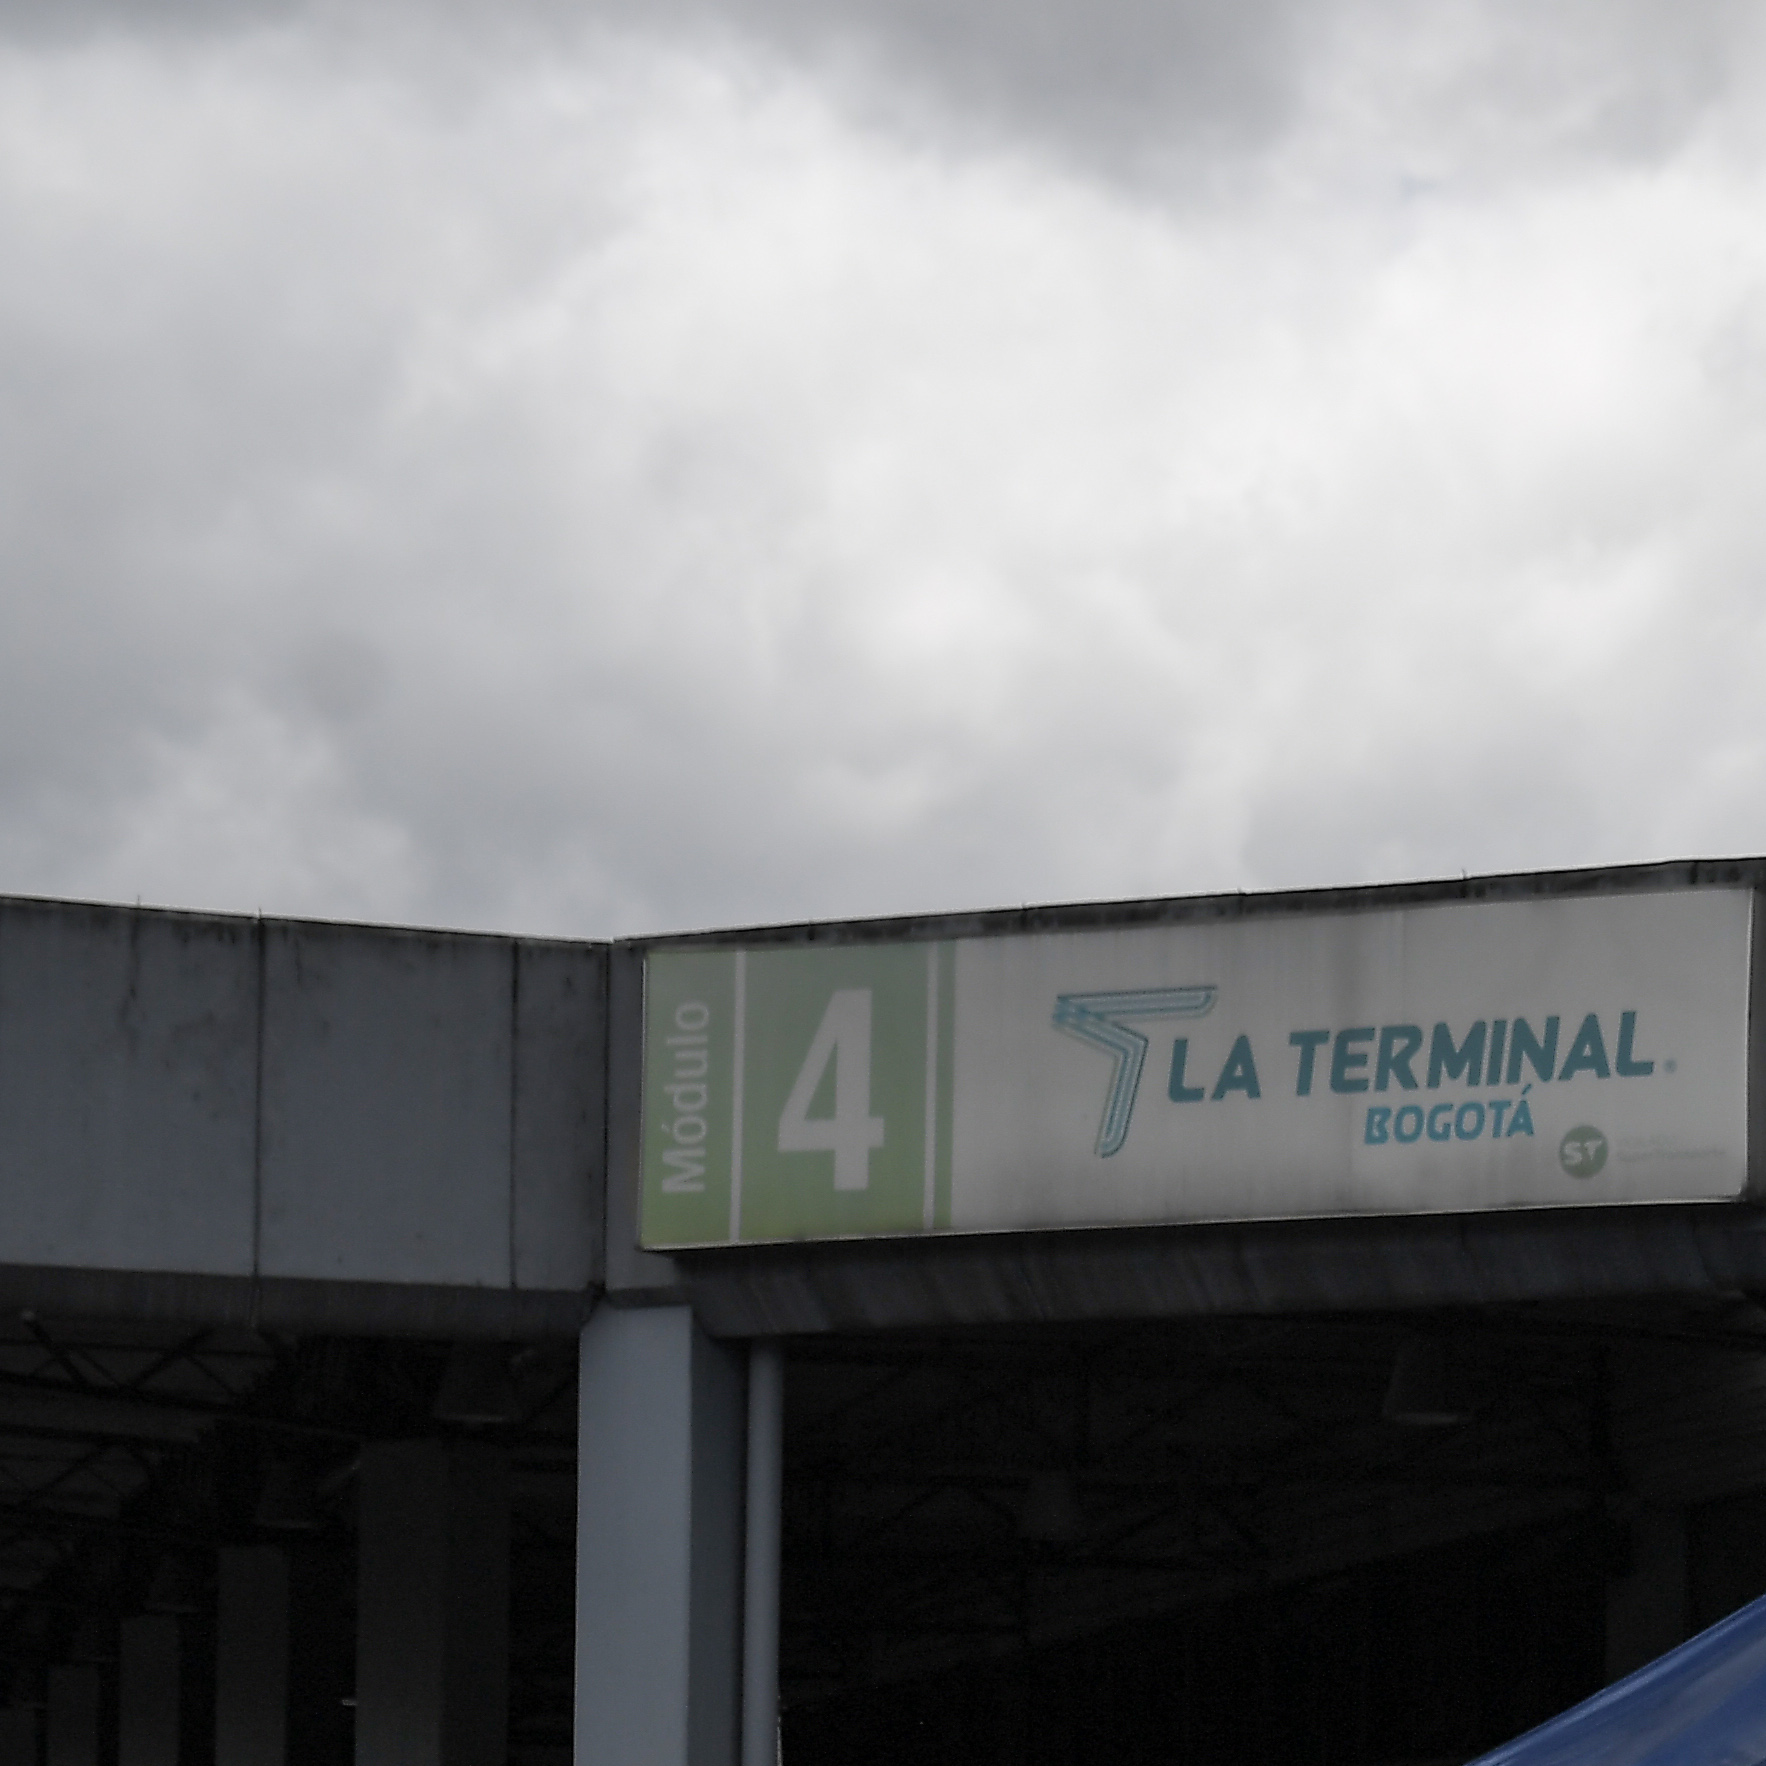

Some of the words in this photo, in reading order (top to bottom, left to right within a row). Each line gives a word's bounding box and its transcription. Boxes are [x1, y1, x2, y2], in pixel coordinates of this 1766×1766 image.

[661, 1001, 709, 1193] Módulo
[778, 988, 885, 1191] 4
[1167, 1034, 1261, 1103] LA
[1289, 1010, 1655, 1096] TERMINAL
[1364, 1083, 1535, 1145] BOGOTÁ
